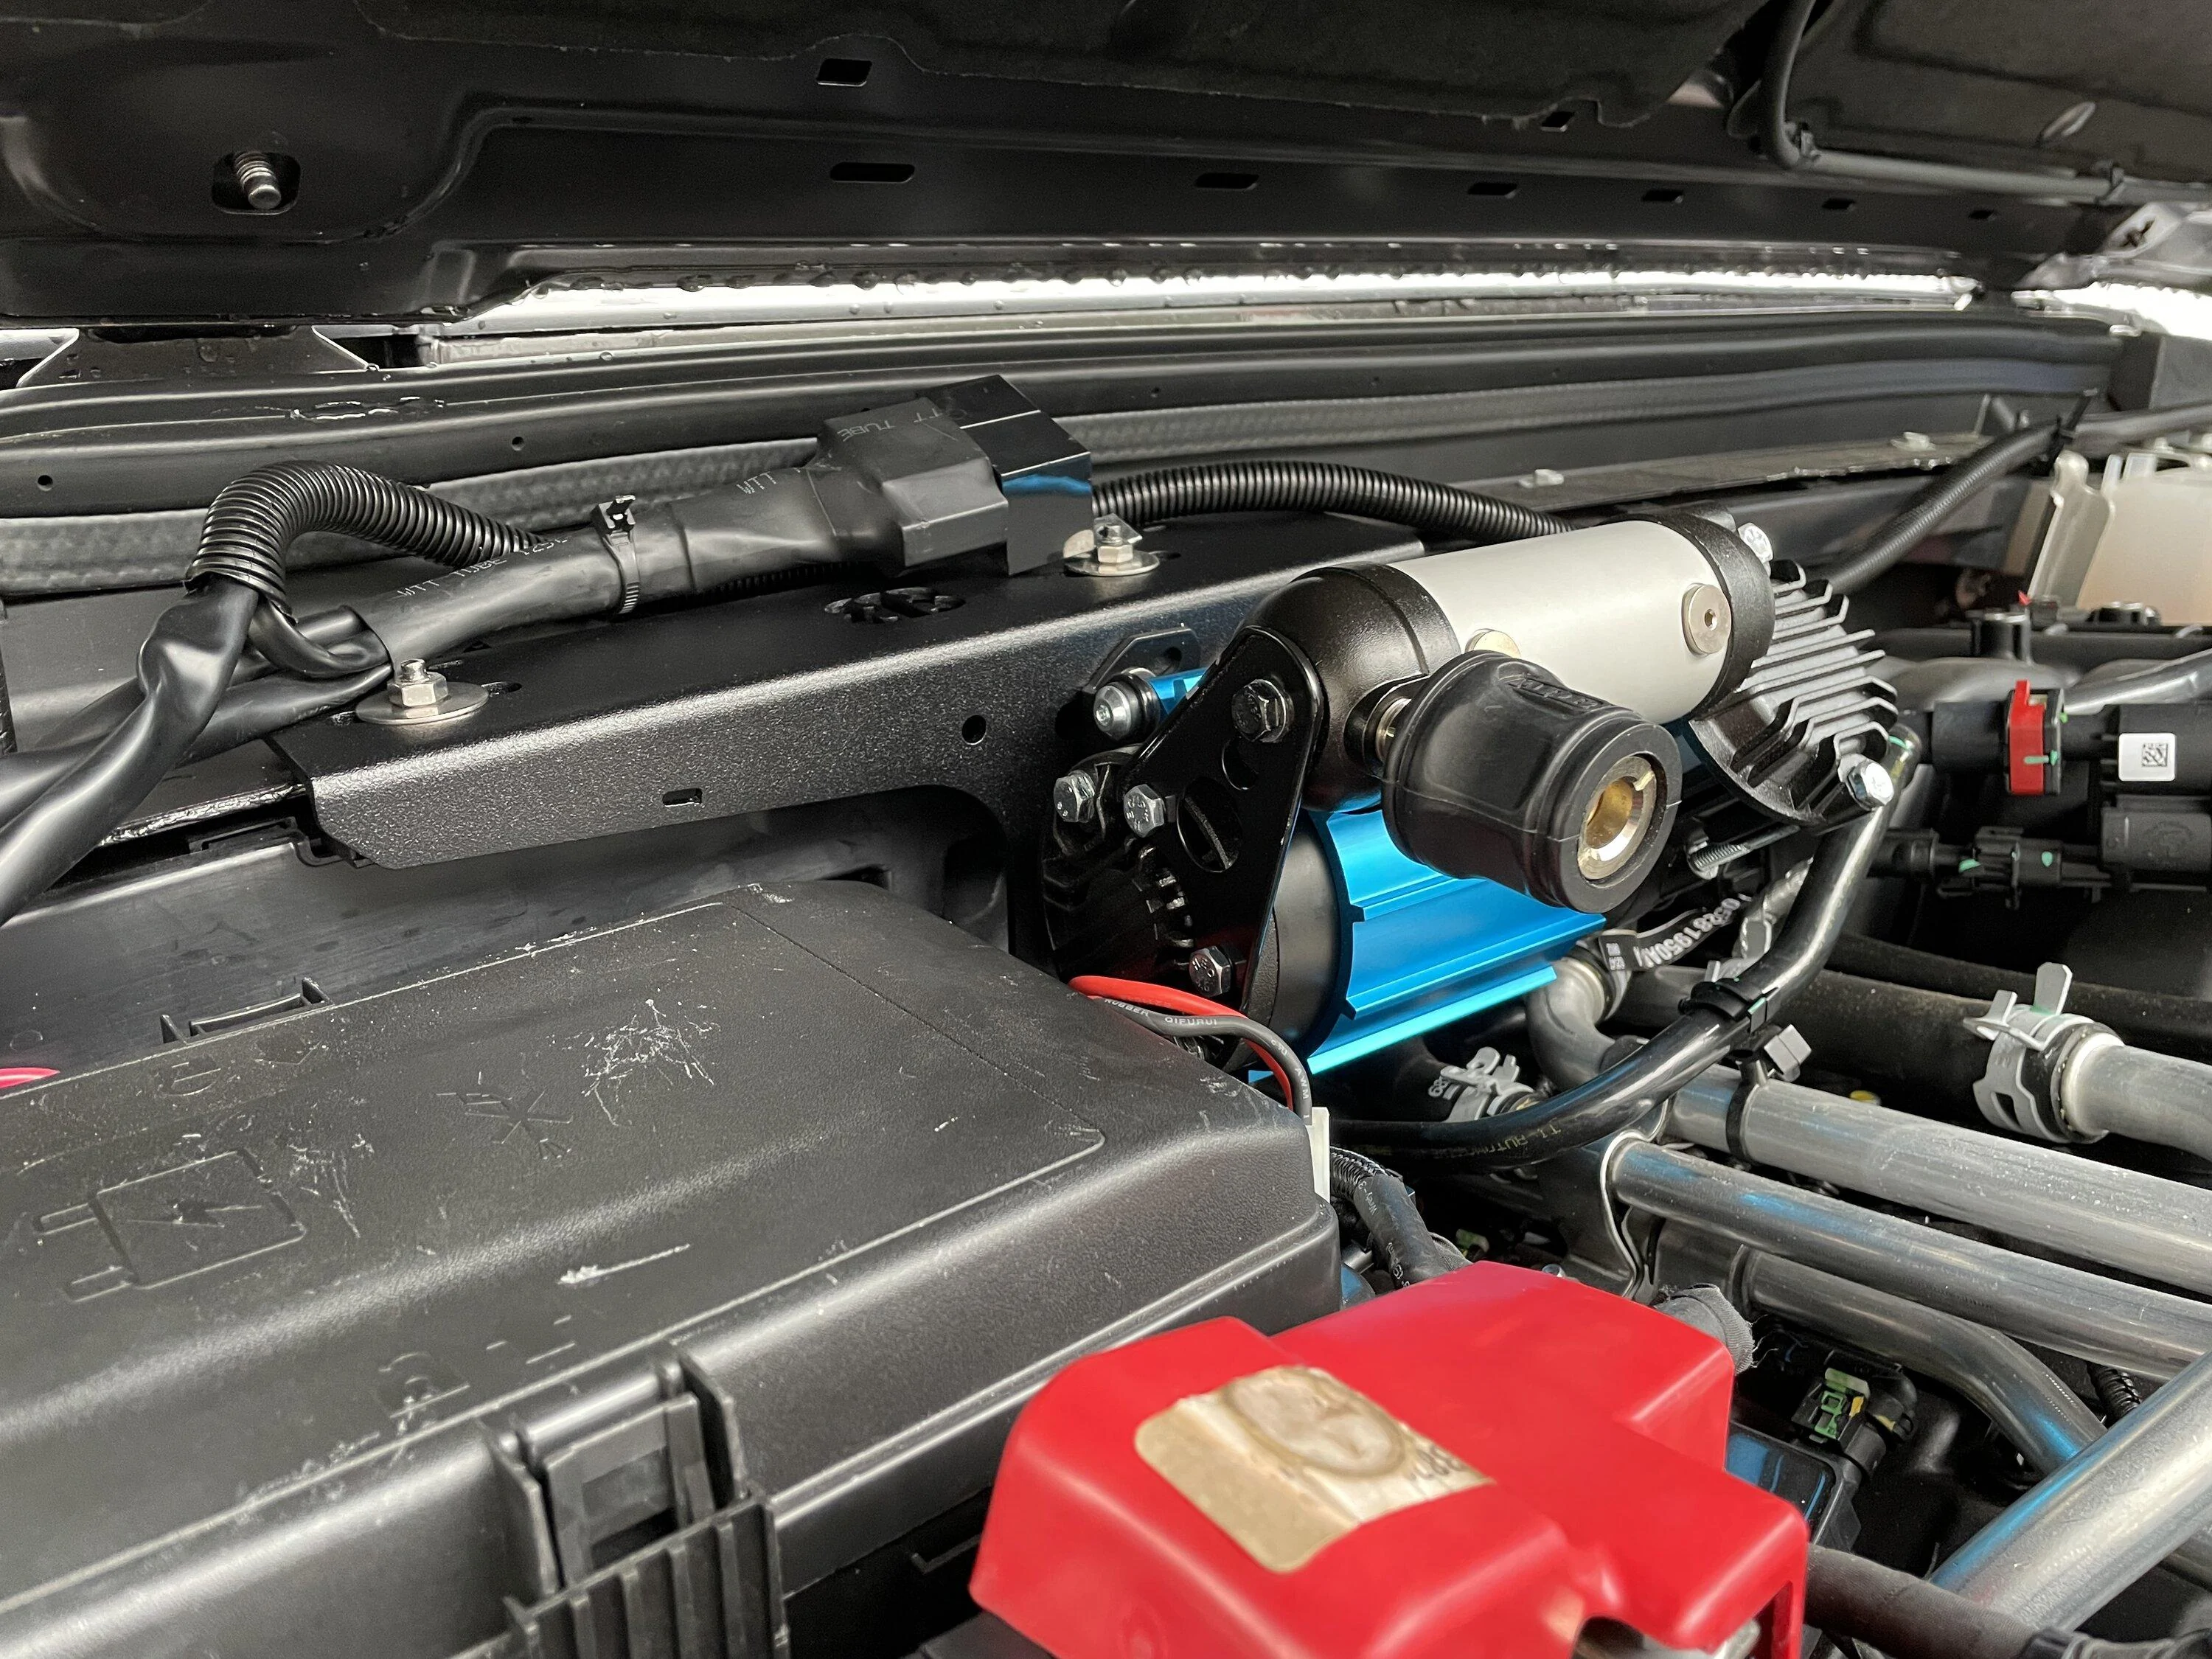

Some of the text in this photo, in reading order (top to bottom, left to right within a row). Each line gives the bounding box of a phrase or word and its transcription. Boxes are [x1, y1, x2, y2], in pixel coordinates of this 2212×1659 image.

[837, 420, 896, 442] TUBE
[1104, 998, 1217, 1026] RUBBER QIFURUI
[1294, 1068, 1310, 1099] AWM
